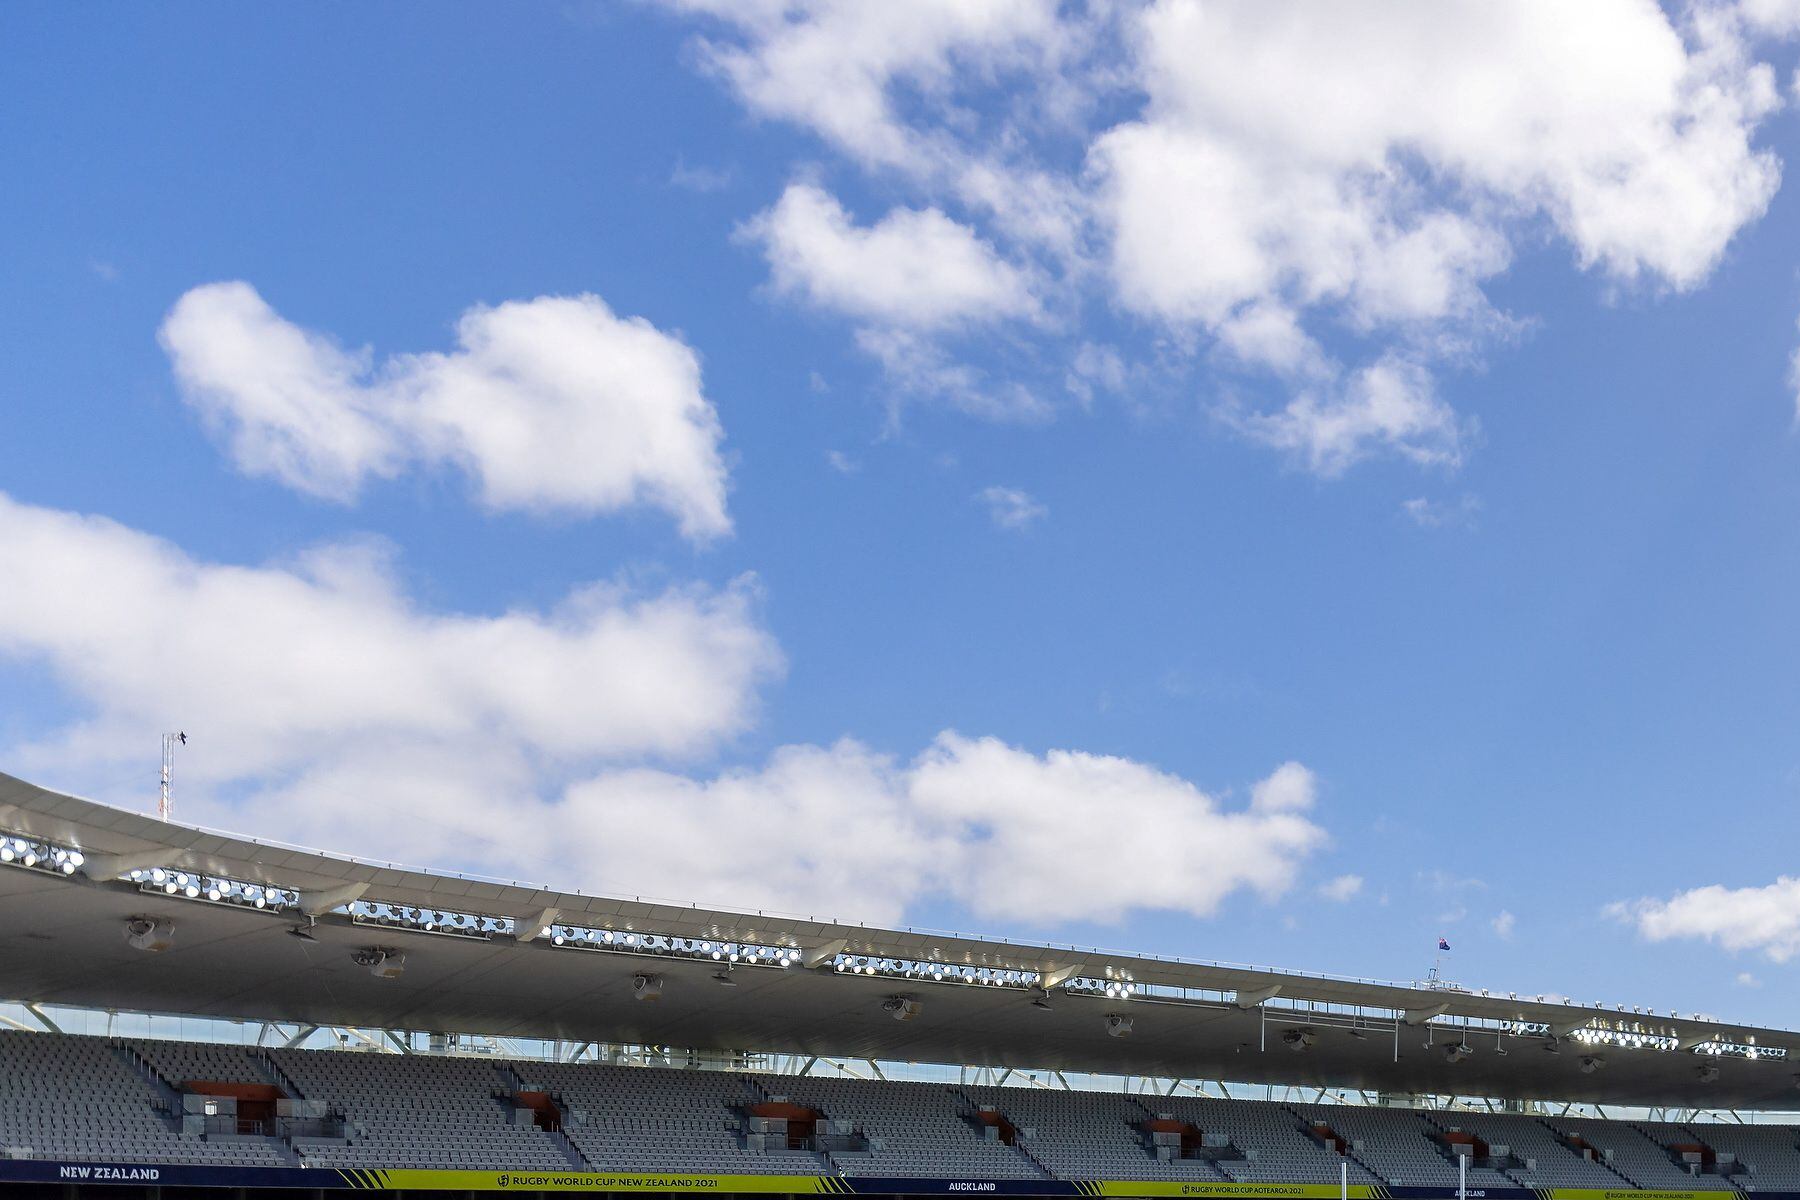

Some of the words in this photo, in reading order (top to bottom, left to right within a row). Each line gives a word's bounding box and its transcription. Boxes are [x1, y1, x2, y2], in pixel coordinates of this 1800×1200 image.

[60, 1166, 91, 1178] NEW
[94, 1168, 160, 1180] ZEALAND
[513, 1177, 549, 1186] RUGBY
[552, 1178, 593, 1186] WORLD
[595, 1178, 616, 1186] CUP
[618, 1178, 643, 1187] NEW
[645, 1179, 692, 1187] ZEALAND
[694, 1179, 718, 1187] 2021
[949, 1182, 996, 1190] AUCKLAND
